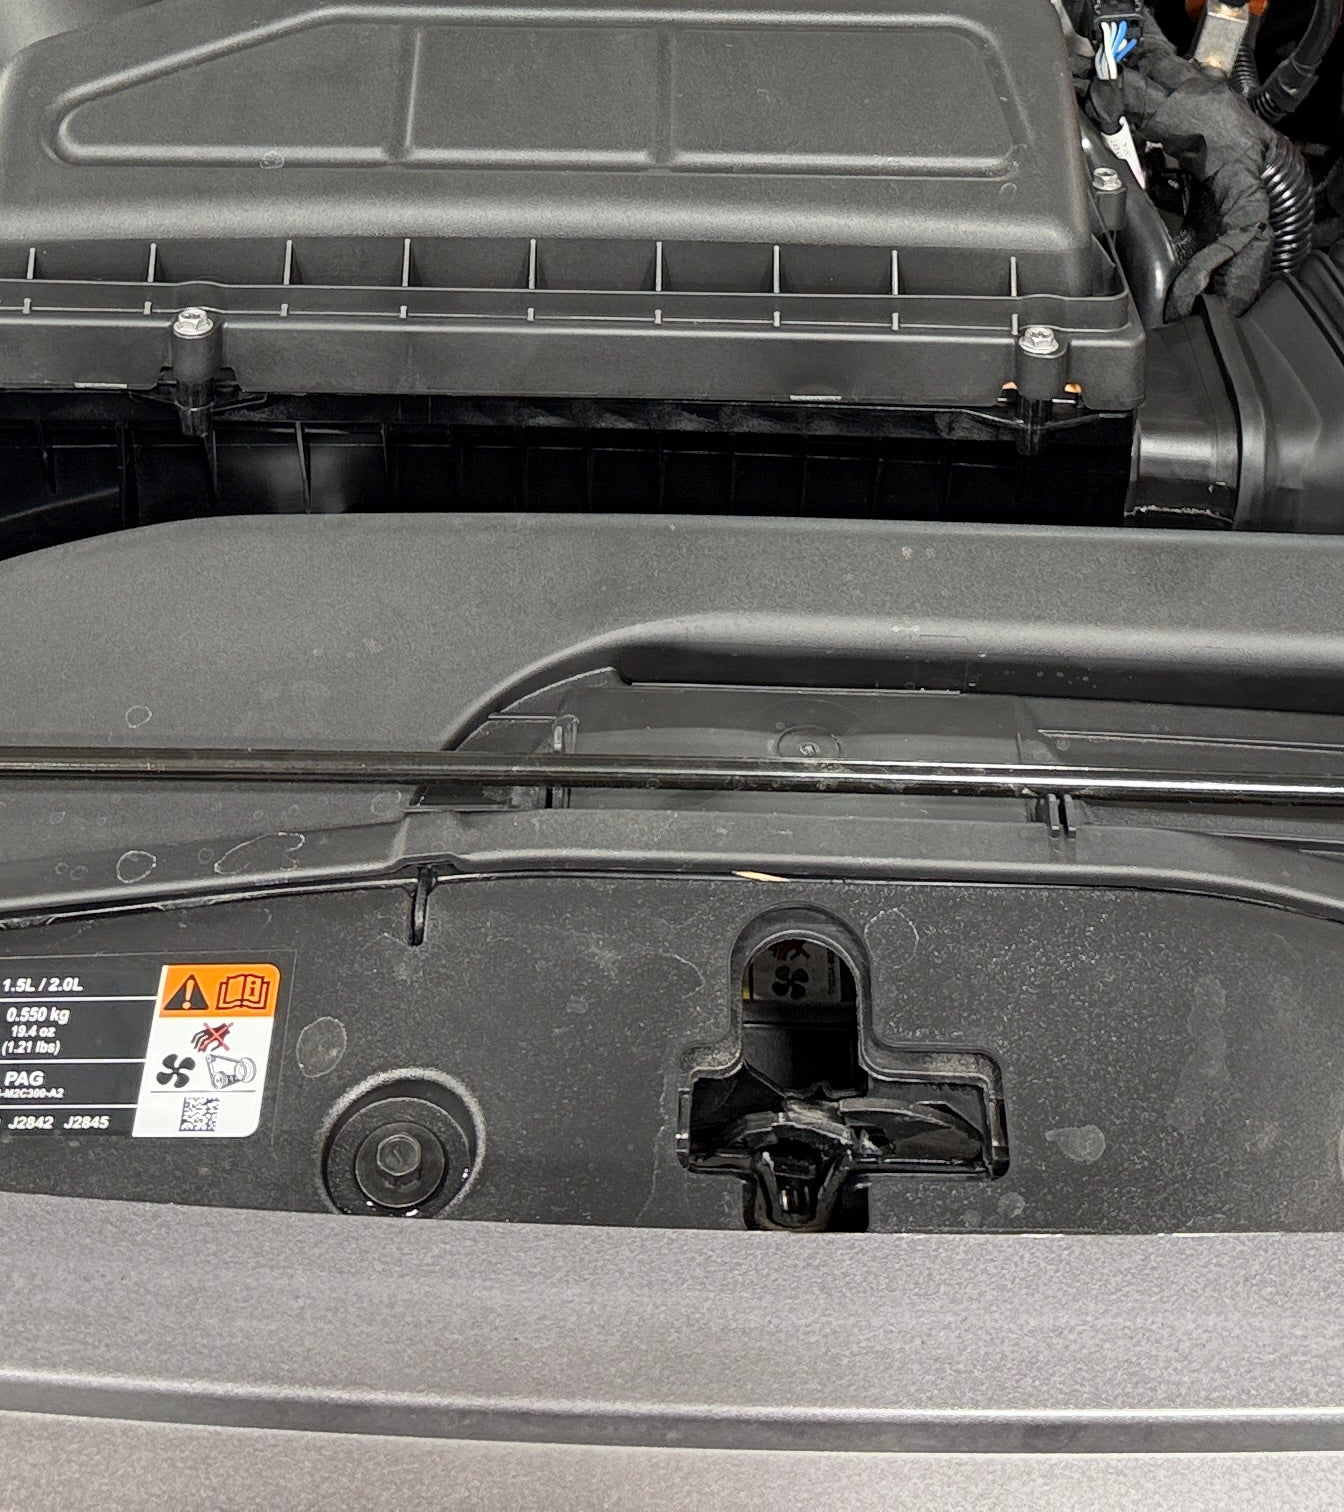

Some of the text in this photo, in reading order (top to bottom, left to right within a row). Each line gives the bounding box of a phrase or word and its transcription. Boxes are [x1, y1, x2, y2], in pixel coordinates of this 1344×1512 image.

[3, 977, 84, 992] 1.5L / 2.0L
[6, 1006, 70, 1025] 0.550 kg
[11, 1025, 56, 1037] 19.4 oz
[2, 1040, 61, 1056] (1.21 lbs)
[4, 1070, 45, 1086] PAG
[8, 1115, 55, 1131] J2842
[64, 1114, 111, 1130] J2845
